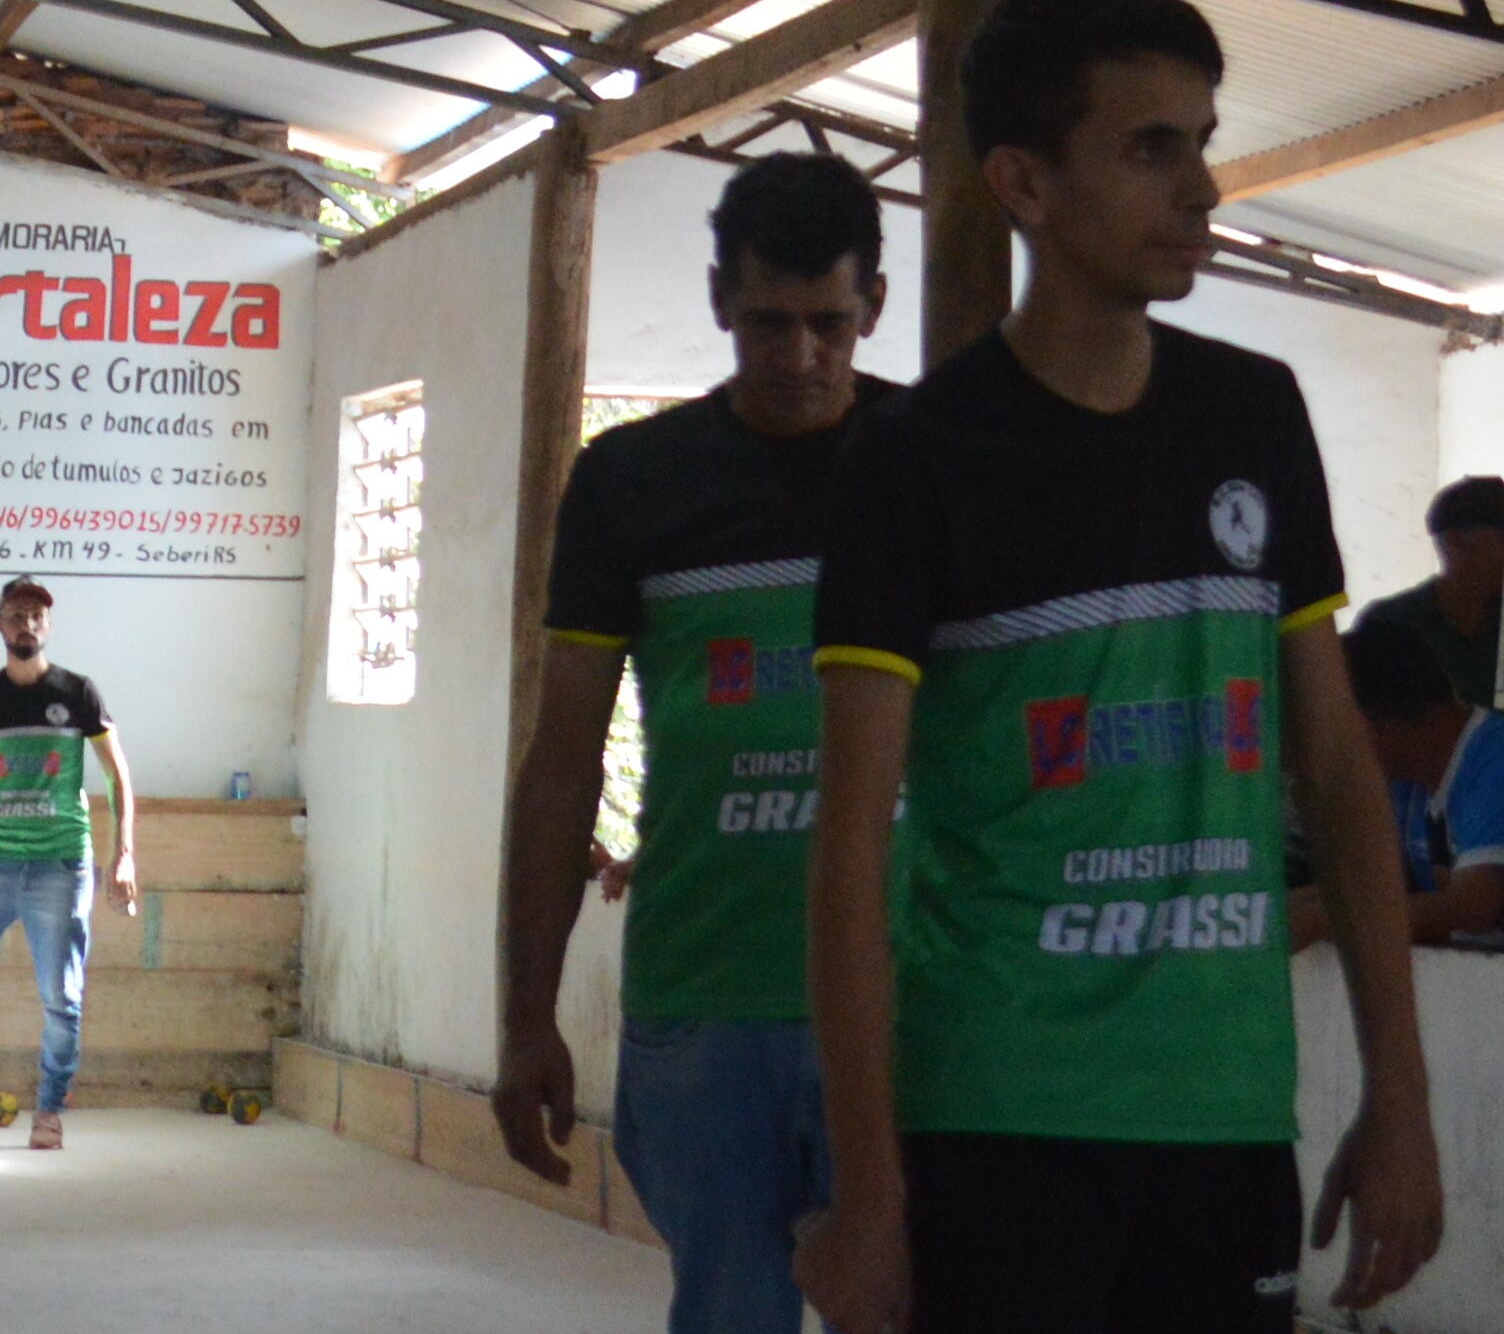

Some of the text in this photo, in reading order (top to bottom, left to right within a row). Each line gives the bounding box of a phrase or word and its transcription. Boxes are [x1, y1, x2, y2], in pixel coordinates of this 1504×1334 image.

[71, 365, 92, 392] e
[106, 356, 242, 397] Granitos
[79, 413, 94, 432] e
[103, 411, 214, 439] bancadas
[231, 420, 270, 441] em
[21, 452, 46, 480] de
[149, 466, 164, 486] e
[82, 540, 111, 562] 49
[135, 542, 210, 564] Seberi
[212, 545, 238, 565] RS
[1038, 891, 1271, 956] GRASSI
